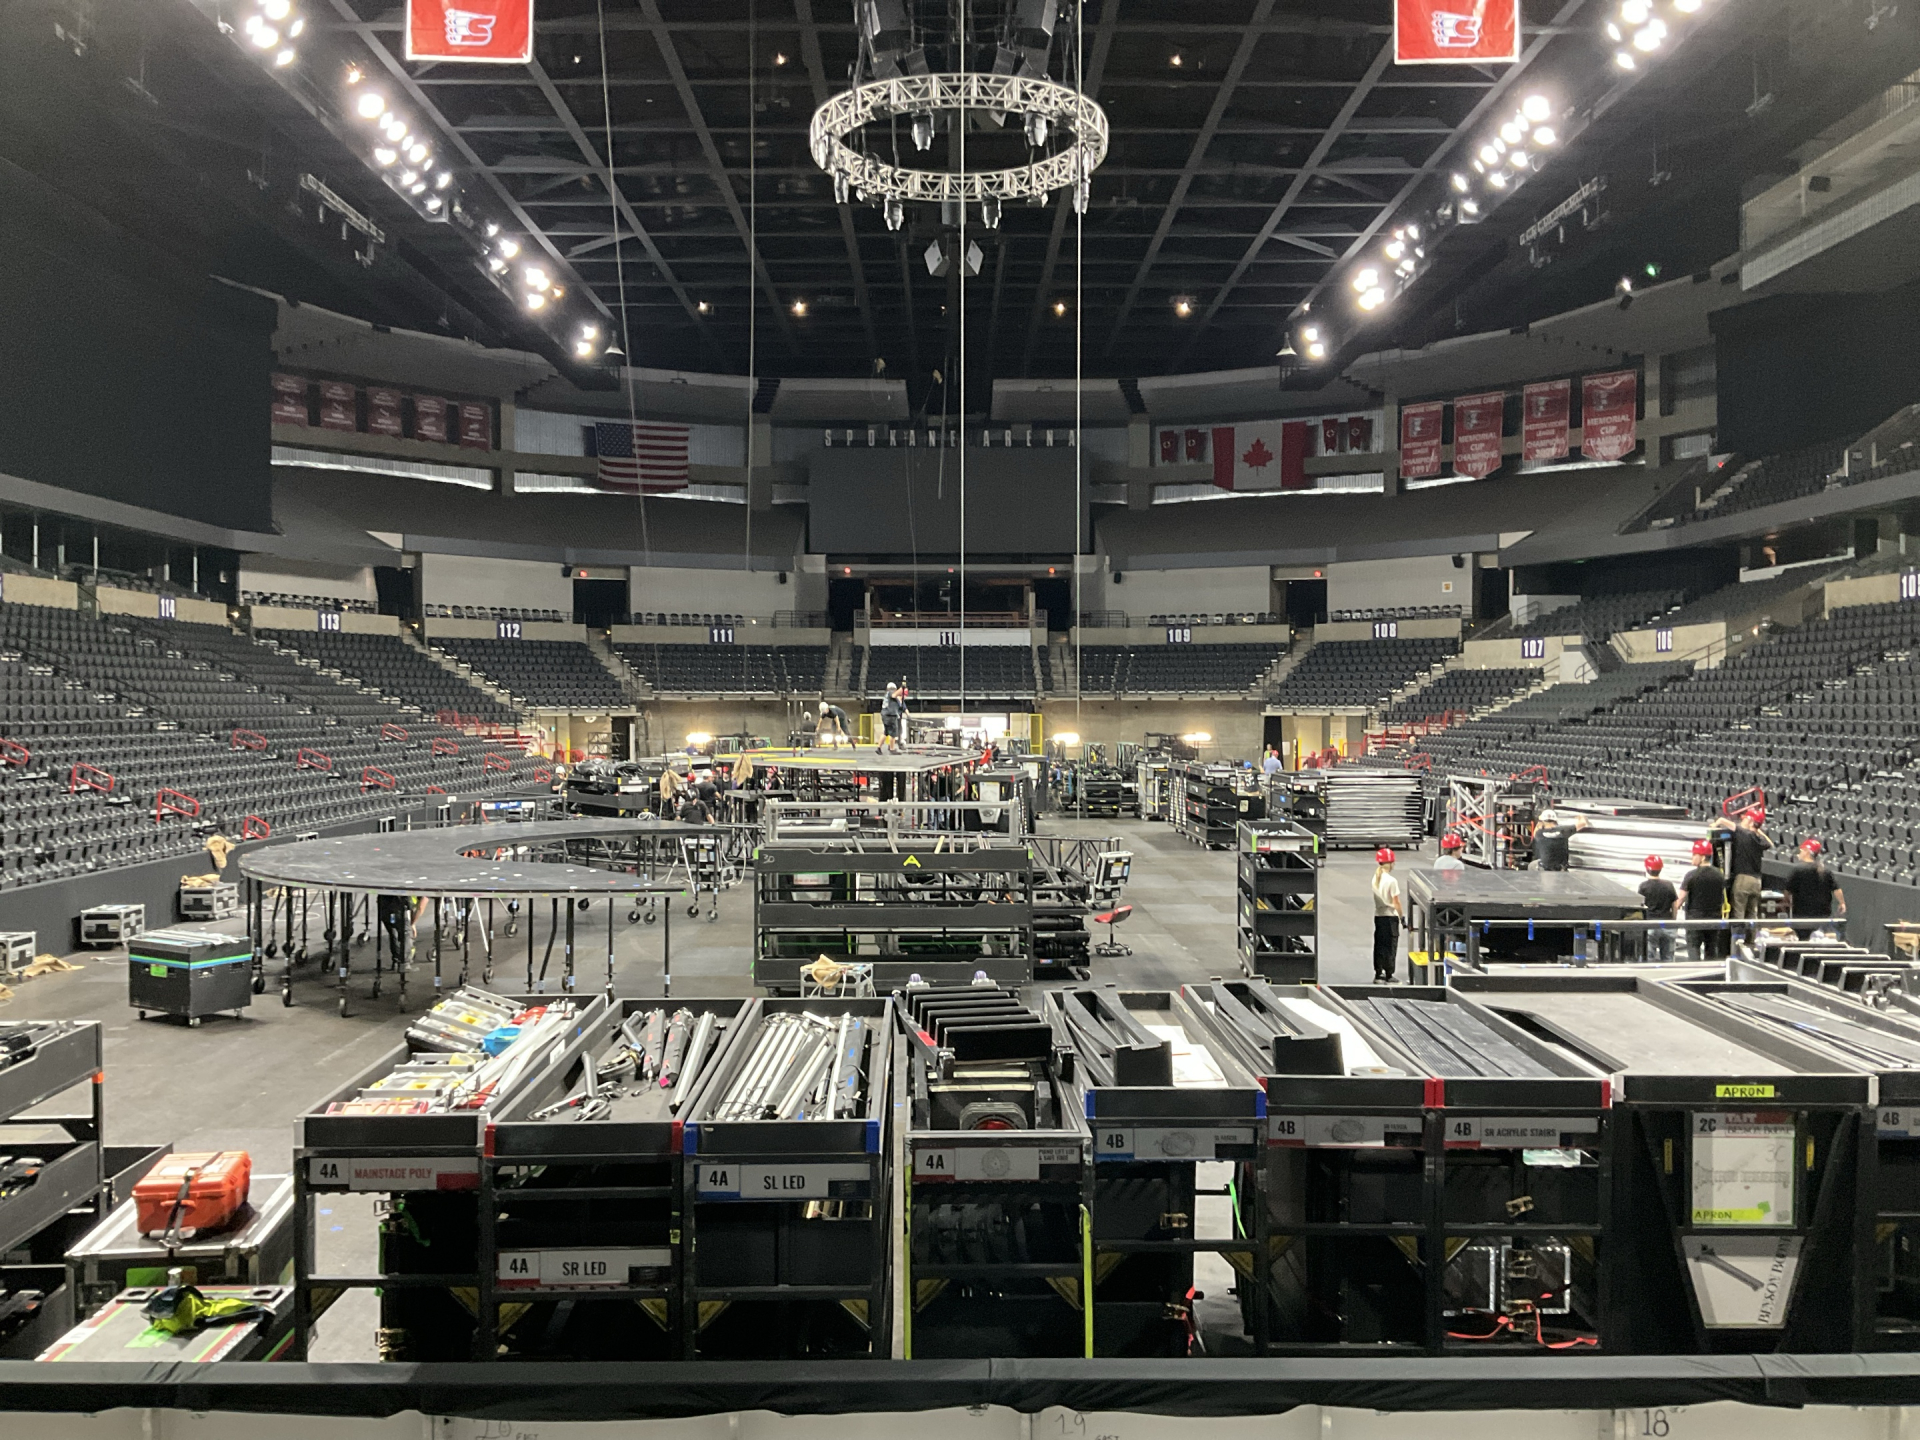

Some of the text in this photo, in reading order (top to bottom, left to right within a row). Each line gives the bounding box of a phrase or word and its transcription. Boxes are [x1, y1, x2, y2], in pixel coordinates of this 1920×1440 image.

[1587, 414, 1630, 426] MEMORIAL
[1458, 432, 1497, 443] MEMORIAL
[1600, 426, 1617, 435] CUP
[1470, 443, 1485, 451] CUP
[1457, 450, 1498, 462] CHAMPIONS
[1412, 465, 1429, 474] 1991
[1468, 462, 1487, 472] 1991
[161, 598, 175, 617] 114
[321, 613, 339, 630] 113
[500, 623, 520, 638] 112
[713, 629, 732, 642] 111
[1169, 629, 1190, 642] 109
[1374, 623, 1396, 638] 108
[941, 632, 961, 645] 110
[1657, 631, 1672, 650] 106
[1524, 640, 1543, 657] 107
[1722, 1086, 1765, 1097] APRON
[1699, 1118, 1717, 1132] 2C
[1882, 1111, 1900, 1126] 4B
[1277, 1120, 1296, 1134] 4B
[1454, 1122, 1557, 1137] 4B SR ACRYLIC STAIRS
[1106, 1134, 1125, 1148] 4B
[925, 1154, 945, 1169] 4A
[319, 1163, 433, 1179] 4A MAINSTAGE POLY
[709, 1171, 806, 1189] 4A SL LED
[1694, 1210, 1732, 1220] APRON
[509, 1258, 607, 1276] 4A SR LED
[1055, 1413, 1086, 1436] 19
[1642, 1408, 1669, 1437] 18
